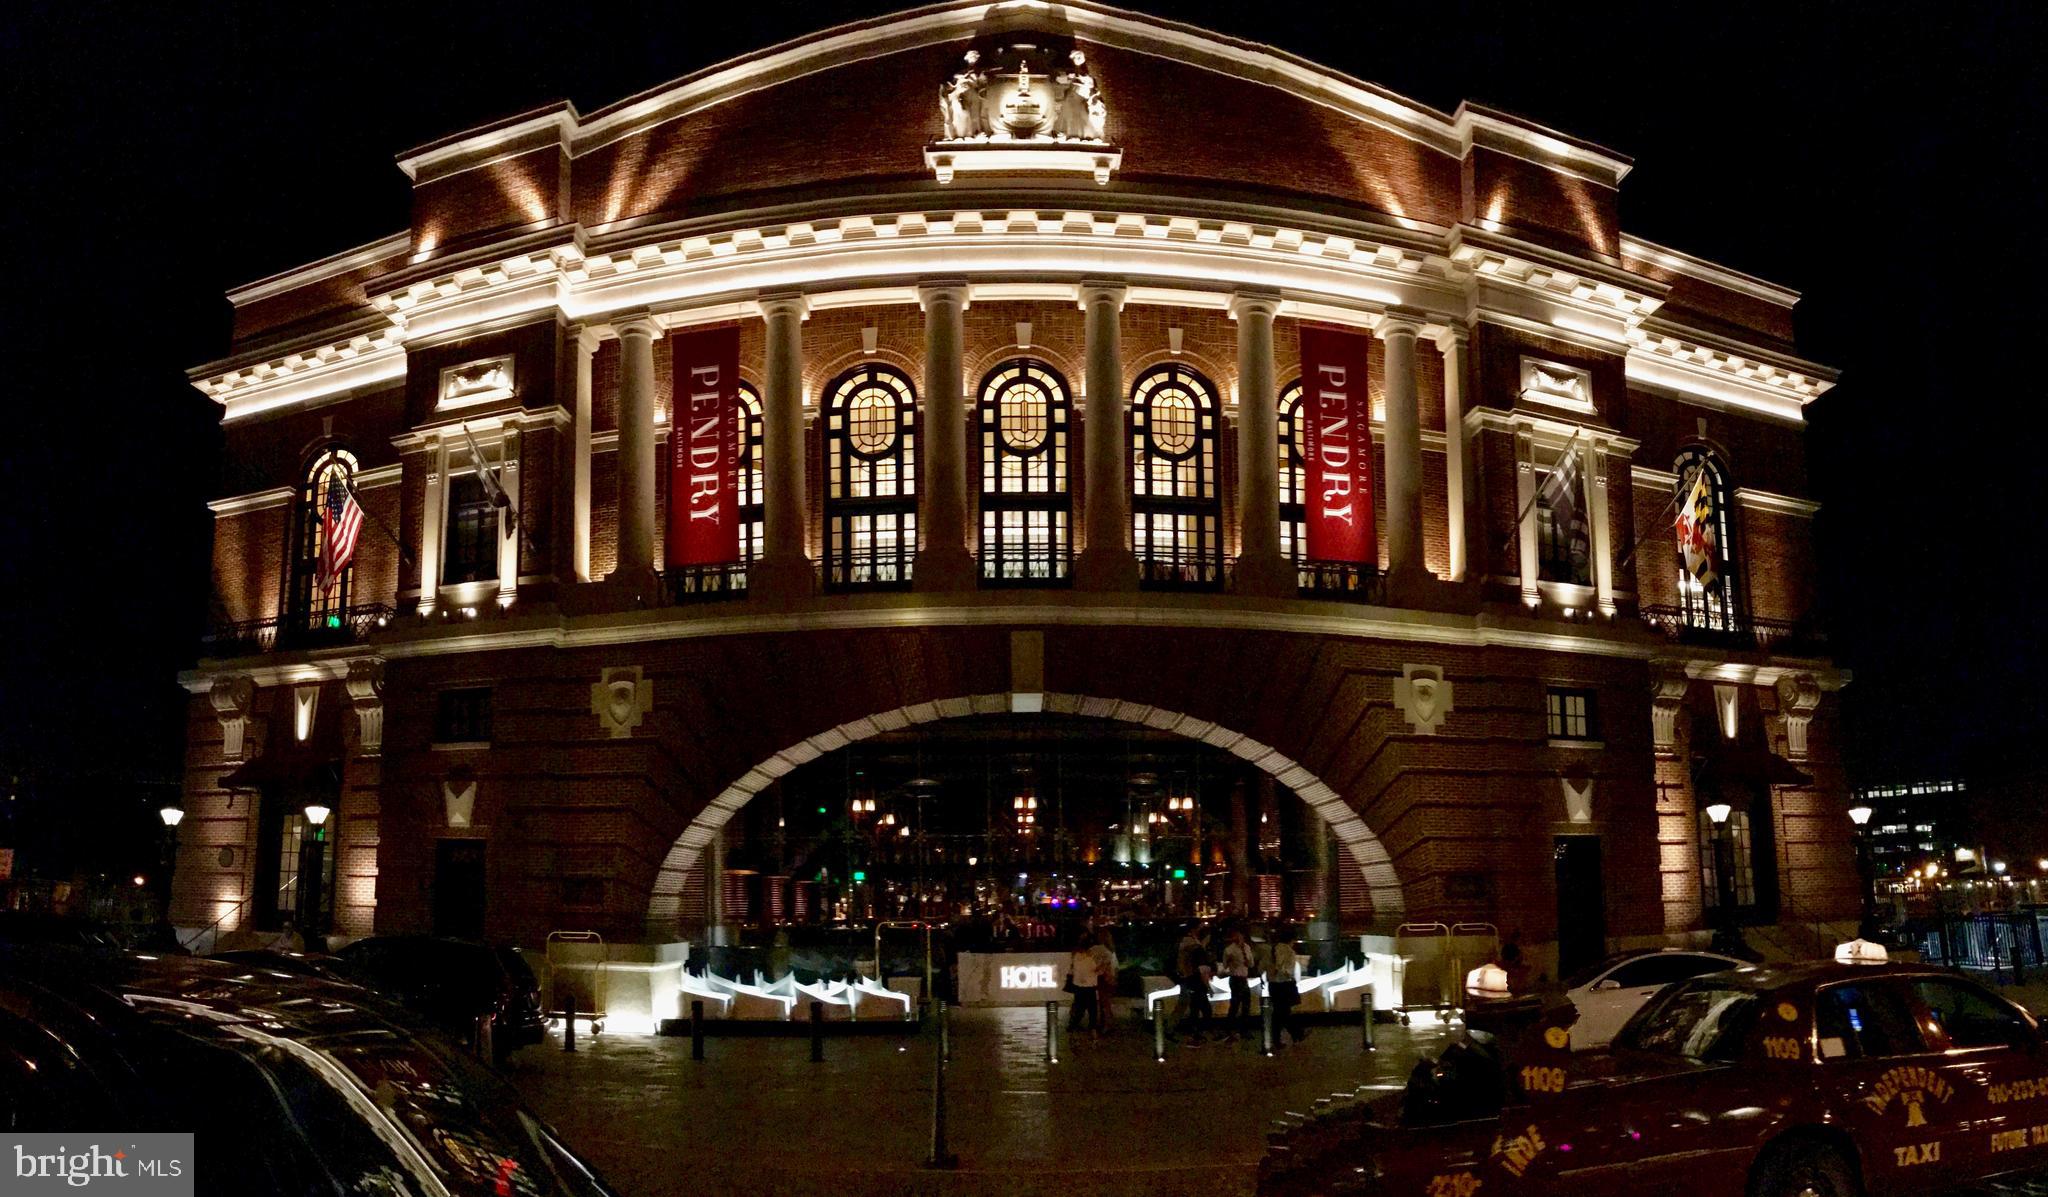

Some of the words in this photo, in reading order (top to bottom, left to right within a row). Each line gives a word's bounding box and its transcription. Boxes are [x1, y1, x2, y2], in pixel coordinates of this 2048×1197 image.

[676, 427, 684, 468] BALTIMORE
[690, 364, 720, 525] PENDRY
[727, 394, 737, 490] SAGAMORE
[1306, 419, 1315, 461] BALTIMORE
[1318, 363, 1353, 527] PENDRY
[1356, 400, 1368, 494] SAGAMORE
[1000, 964, 1057, 988] HOTEL
[1763, 1036, 1800, 1060] 1109
[1521, 1066, 1566, 1093] 1109
[1893, 1141, 1941, 1167] TAXI
